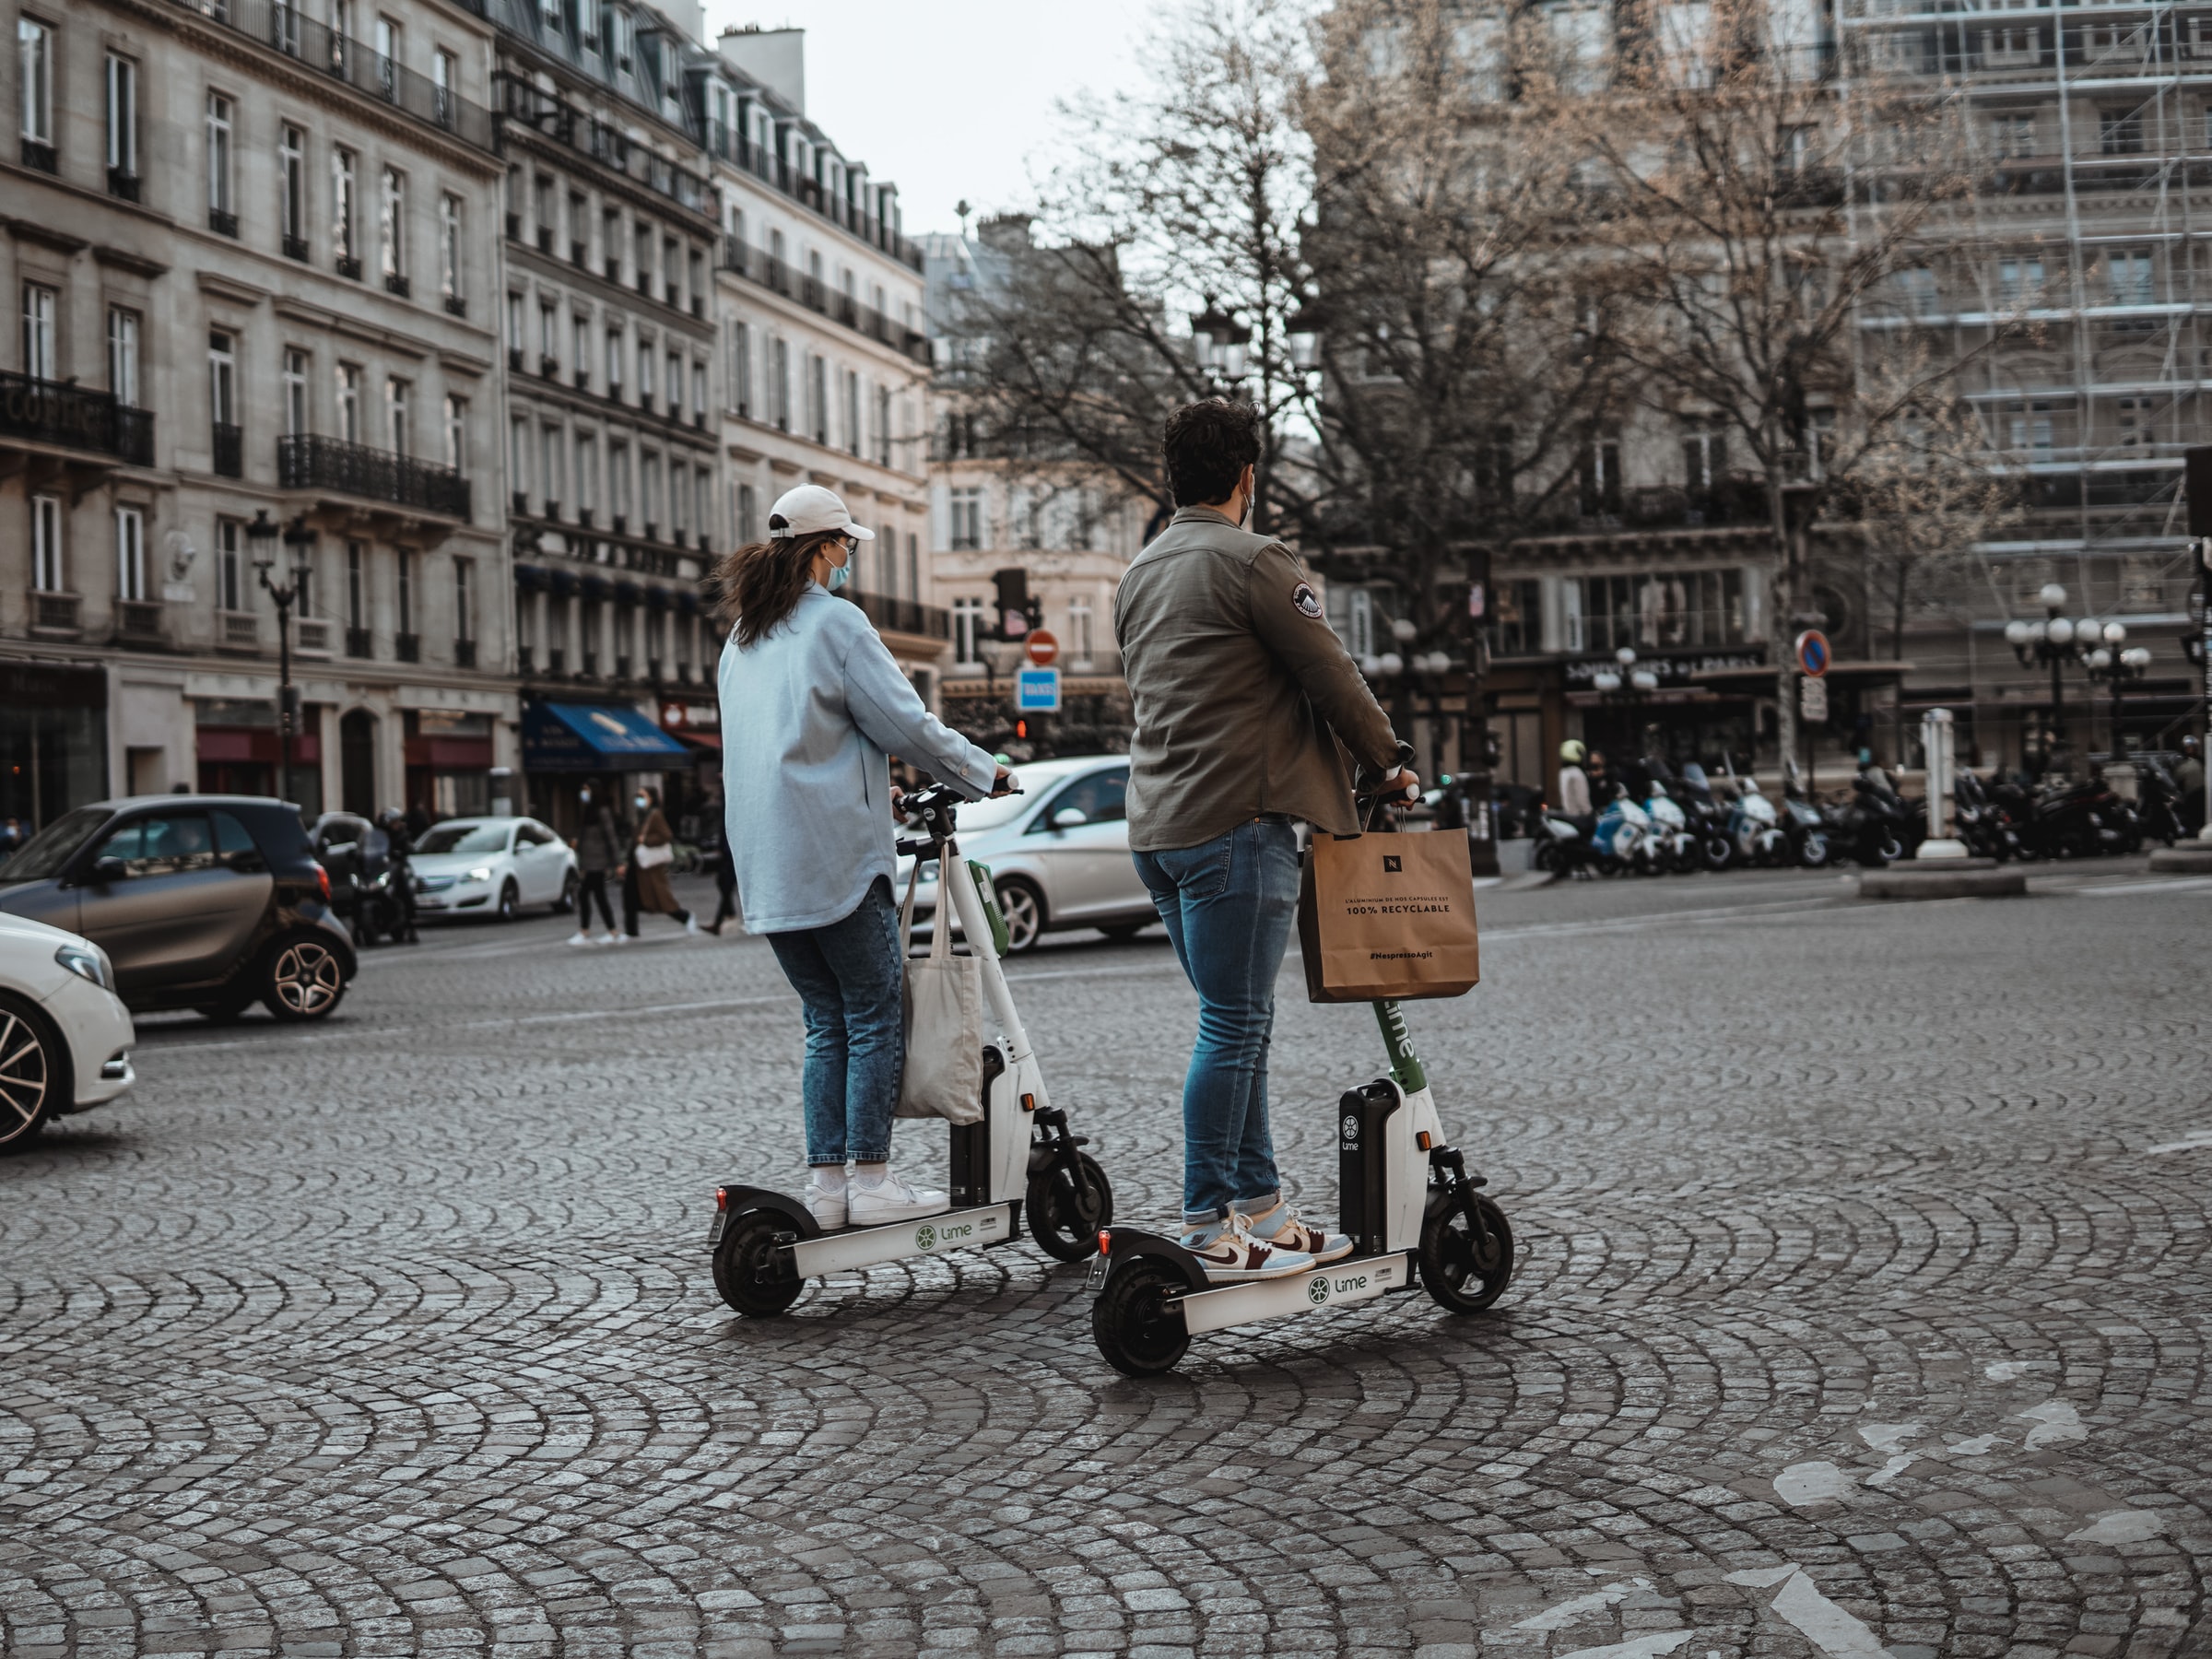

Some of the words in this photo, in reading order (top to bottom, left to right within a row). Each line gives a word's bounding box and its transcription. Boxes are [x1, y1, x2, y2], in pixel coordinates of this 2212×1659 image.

[1347, 906, 1378, 915] 100%
[1382, 904, 1451, 914] RECYCLABLE
[1370, 950, 1433, 960] #NespressoAgit
[1342, 1142, 1359, 1151] Lime
[941, 1224, 972, 1240] Lime
[1335, 1276, 1367, 1292] Lime
